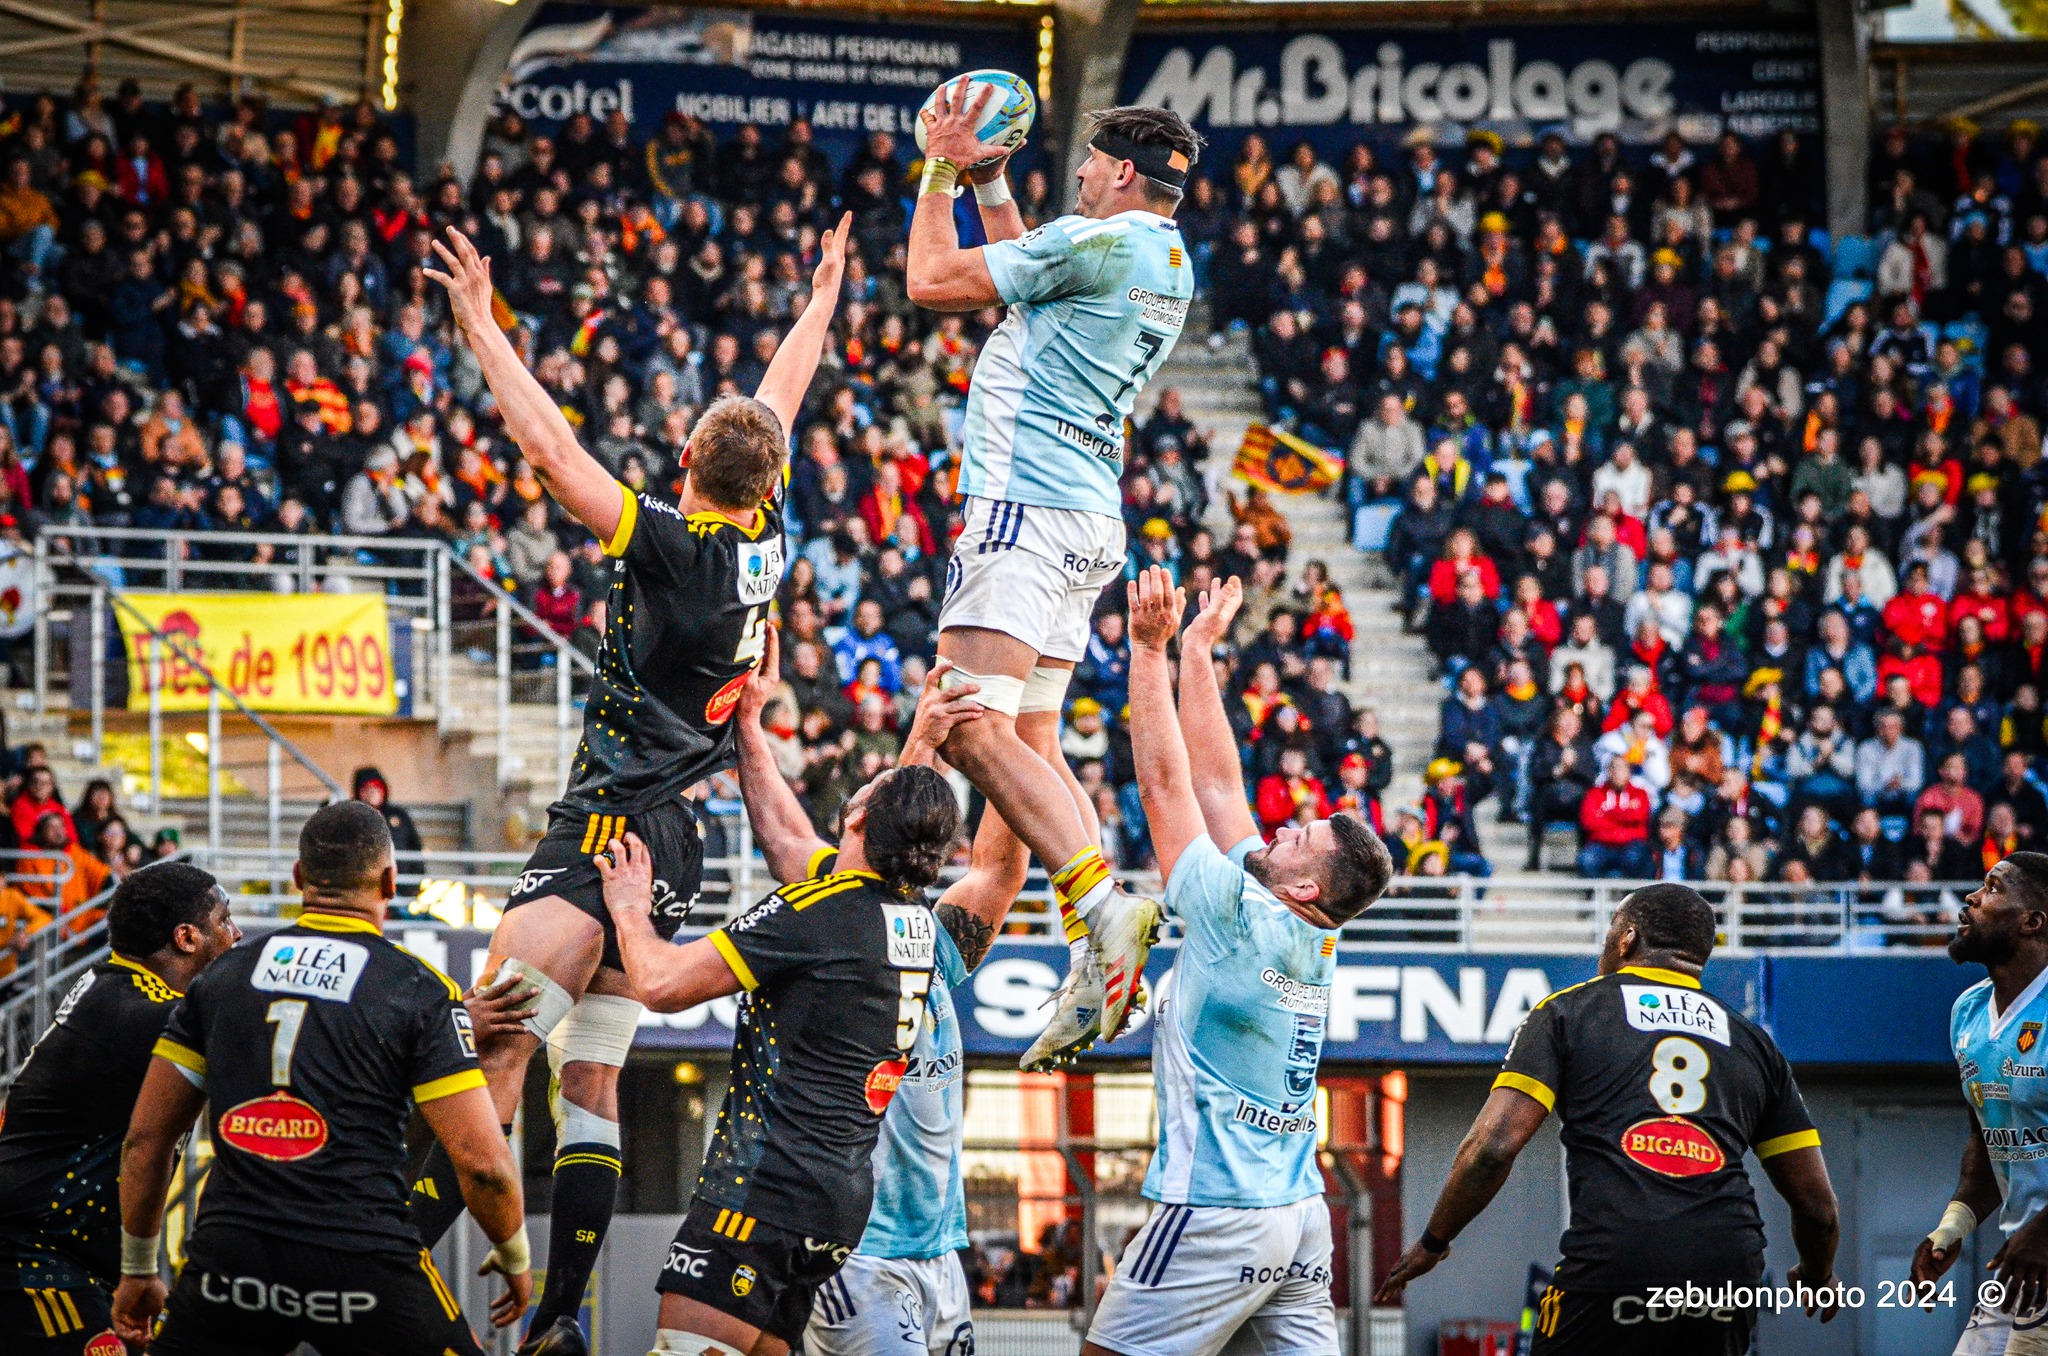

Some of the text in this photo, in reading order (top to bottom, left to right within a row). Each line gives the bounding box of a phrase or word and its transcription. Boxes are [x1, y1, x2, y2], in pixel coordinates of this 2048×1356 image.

[835, 38, 961, 67] PERPIGNAN
[676, 92, 791, 125] MOBILIER
[812, 101, 859, 129] ART
[863, 103, 896, 133] DE
[1129, 288, 1167, 309] GROUPE
[1114, 330, 1164, 402] 7
[228, 629, 274, 696] de
[289, 632, 384, 698] 1999
[909, 910, 931, 940] LÉA
[298, 943, 347, 974] LÉA
[894, 941, 931, 959] NATURE
[262, 967, 344, 992] NATURE
[1261, 969, 1309, 1000] GROUPE
[896, 970, 930, 1051] 5
[1664, 994, 1715, 1020] LÉA
[1639, 1010, 1717, 1035] NATURE
[265, 999, 308, 1087] 1
[1650, 1037, 1711, 1115] 8
[2008, 1060, 2045, 1077] Azura
[228, 1116, 321, 1140] BIGARD
[1630, 1132, 1716, 1165] BIGARD
[575, 1229, 597, 1244] SR
[201, 1271, 378, 1324] COGEP
